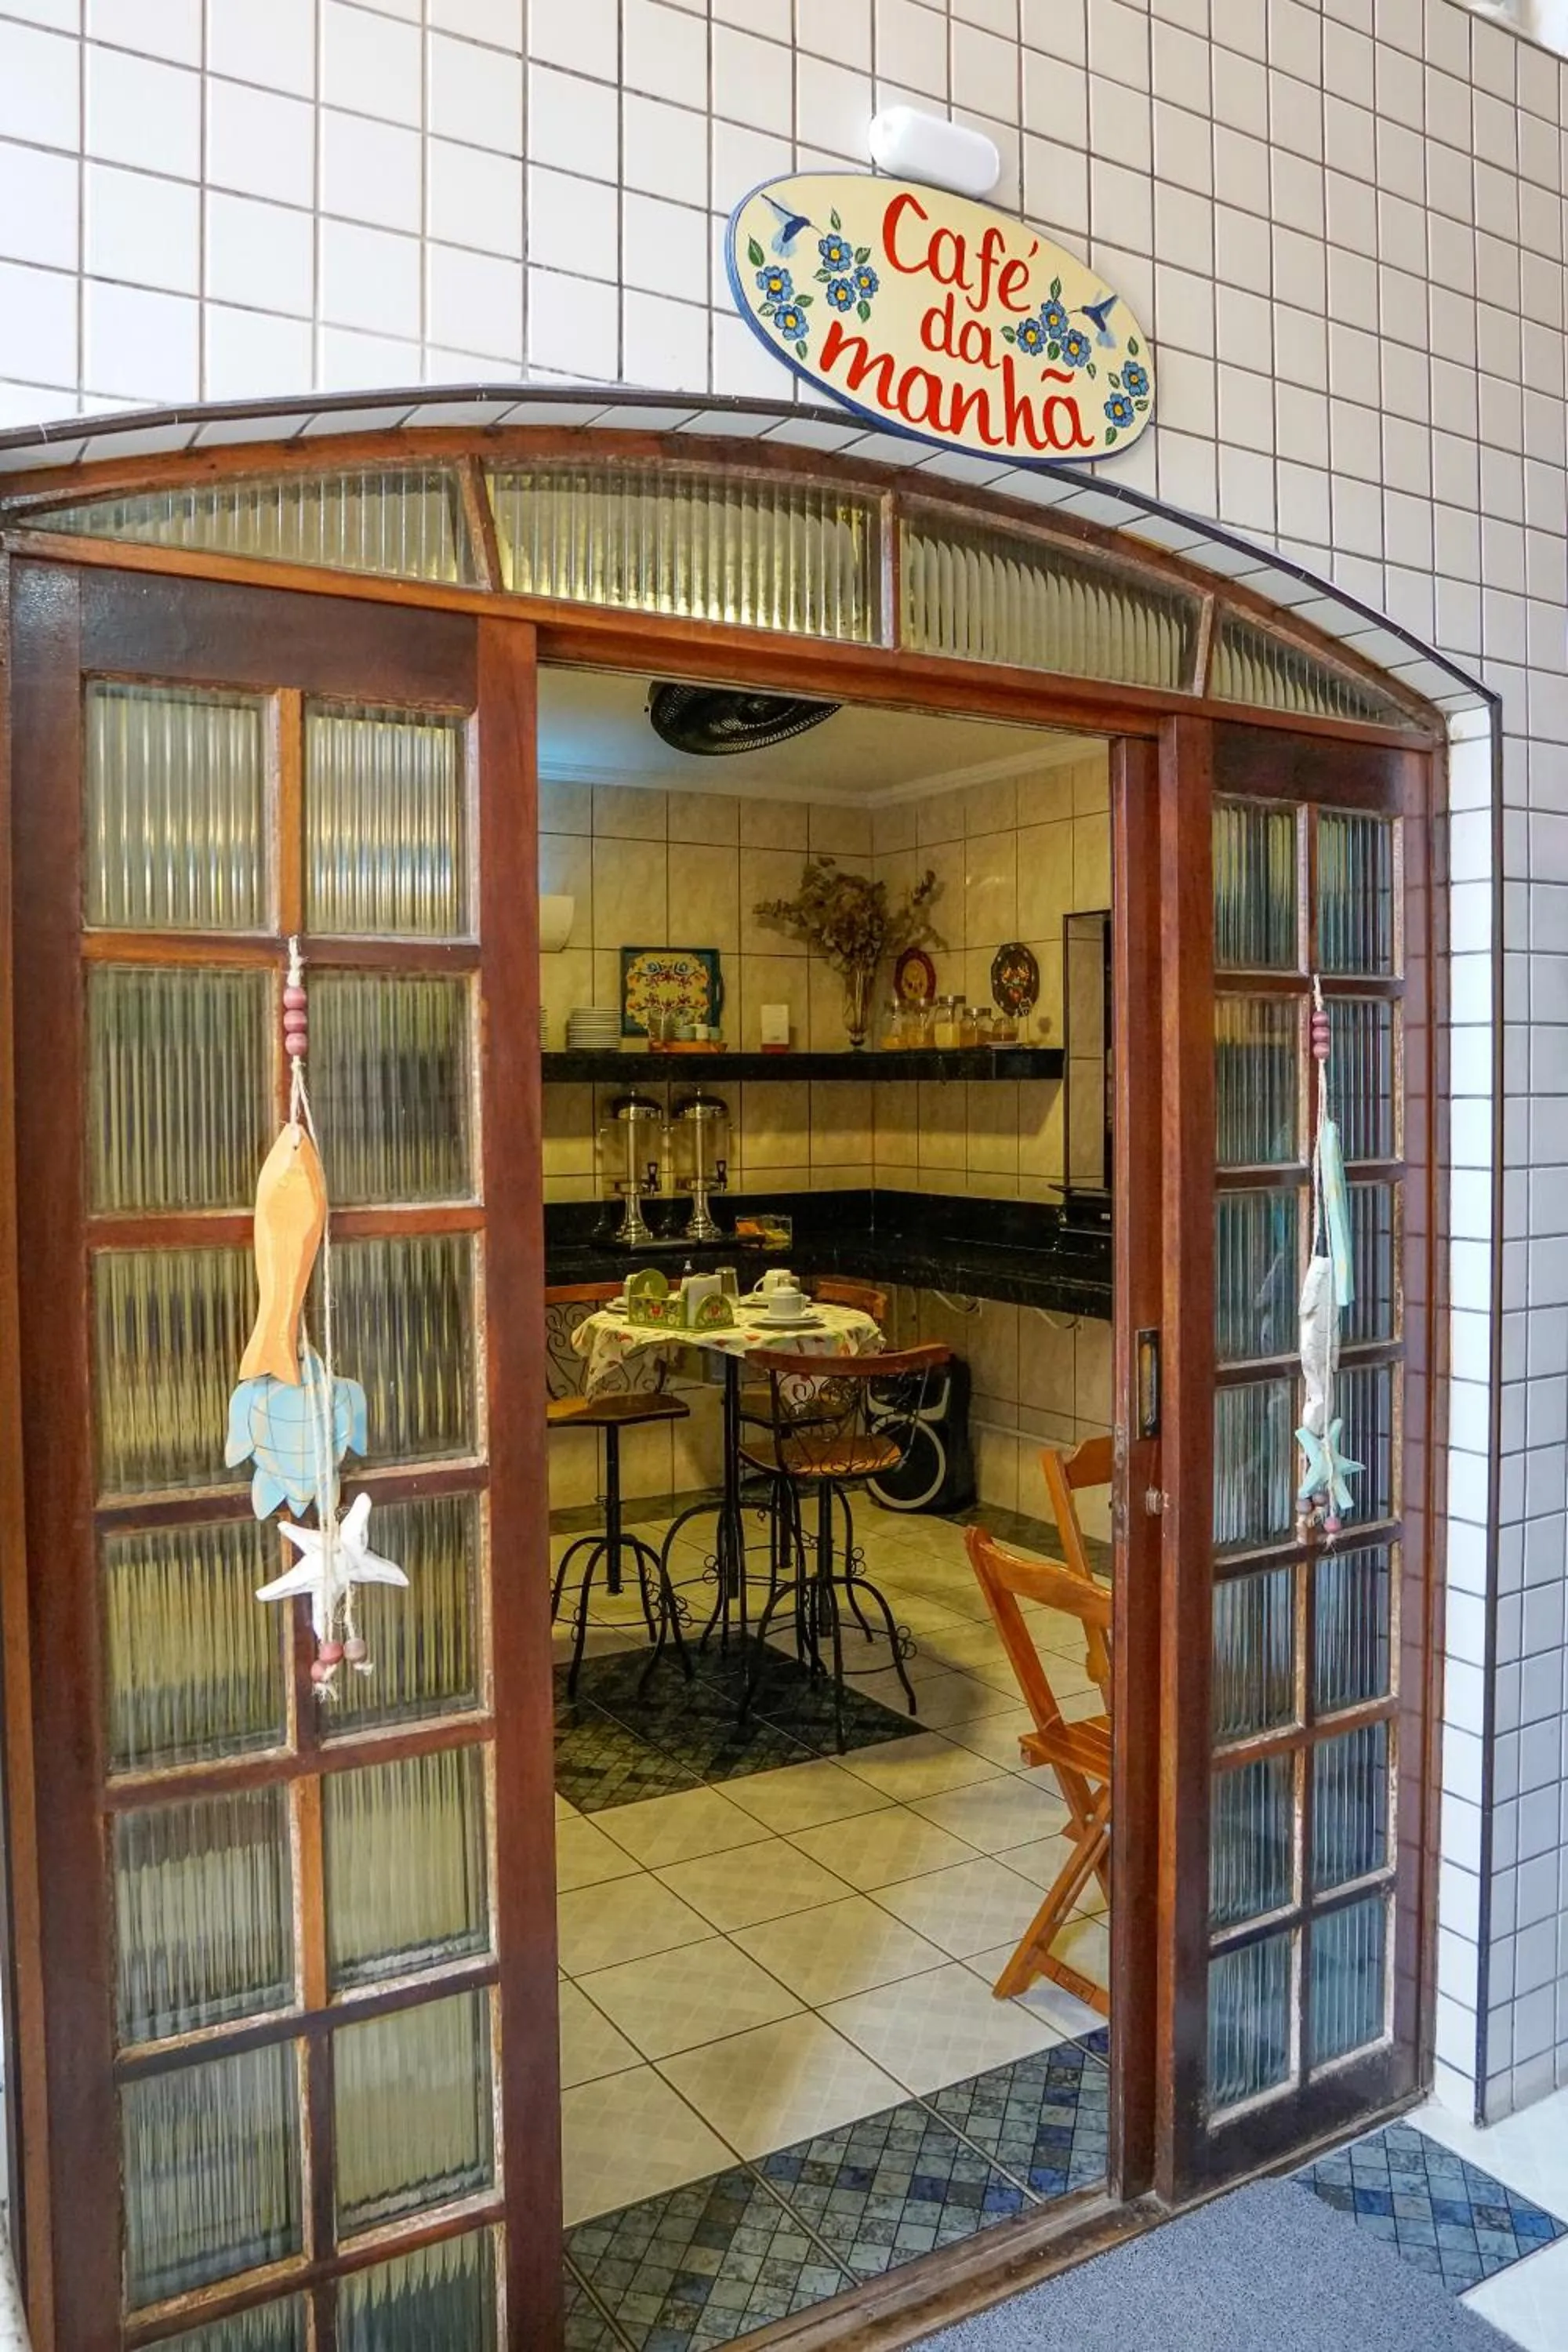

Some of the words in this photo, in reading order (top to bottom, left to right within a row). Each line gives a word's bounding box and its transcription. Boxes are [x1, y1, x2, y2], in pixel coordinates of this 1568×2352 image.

[882, 193, 1039, 313] Café
[818, 320, 1095, 451] manhã
[920, 292, 1000, 370] da
